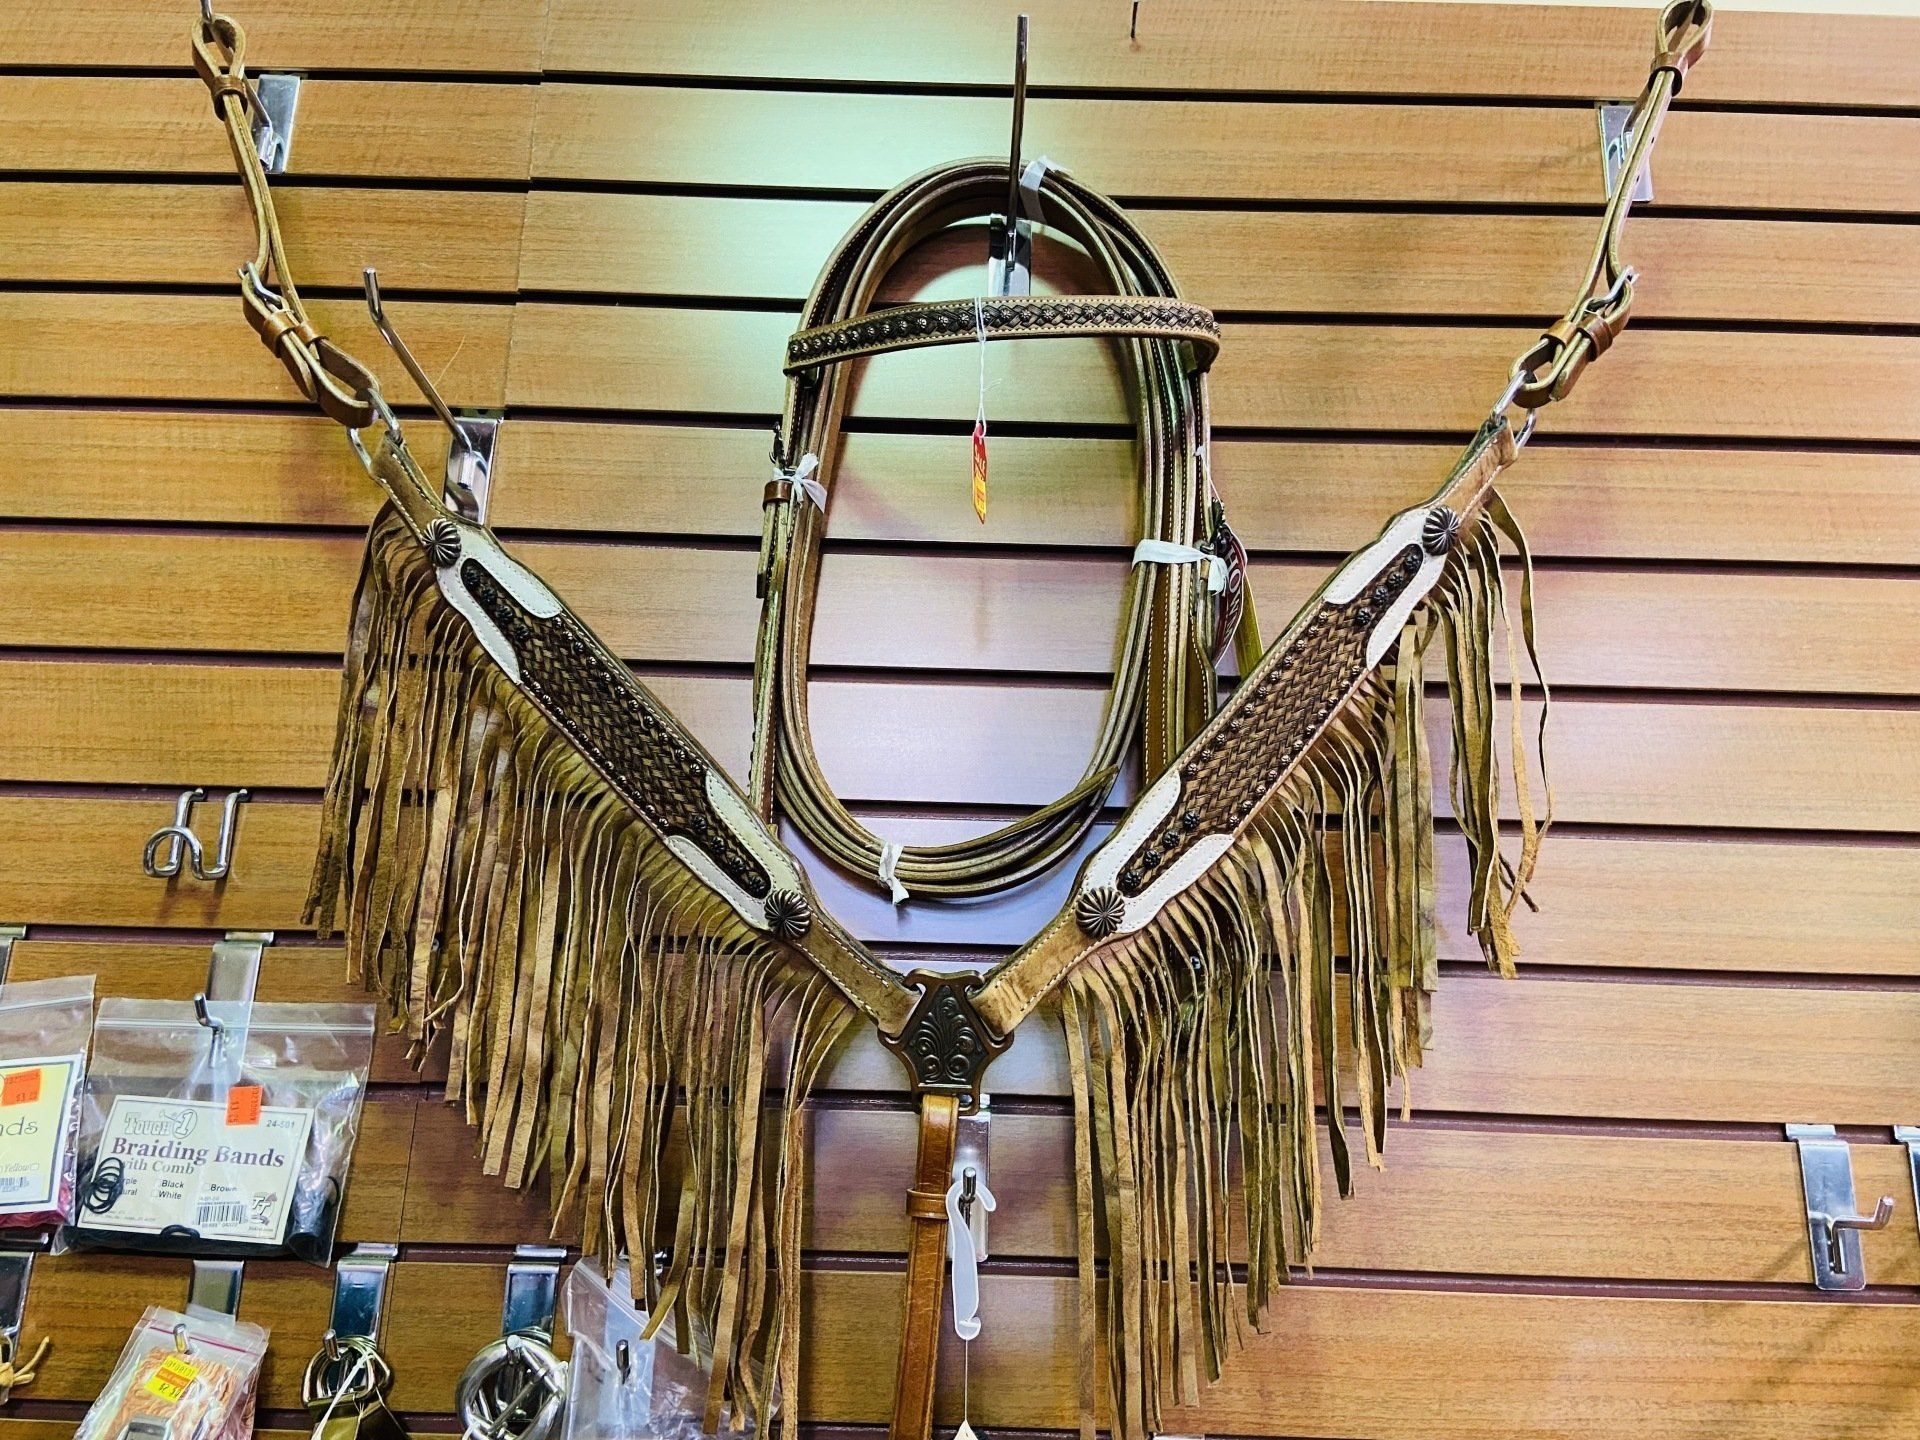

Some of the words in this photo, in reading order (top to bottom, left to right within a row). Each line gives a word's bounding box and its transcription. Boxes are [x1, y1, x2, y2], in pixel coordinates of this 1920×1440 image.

[111, 1137, 209, 1166] Braiding
[214, 1145, 285, 1168] Bands
[152, 1160, 195, 1175] Comb
[161, 1179, 185, 1189] Black
[210, 1183, 238, 1192] Brown
[158, 1190, 182, 1200] White
